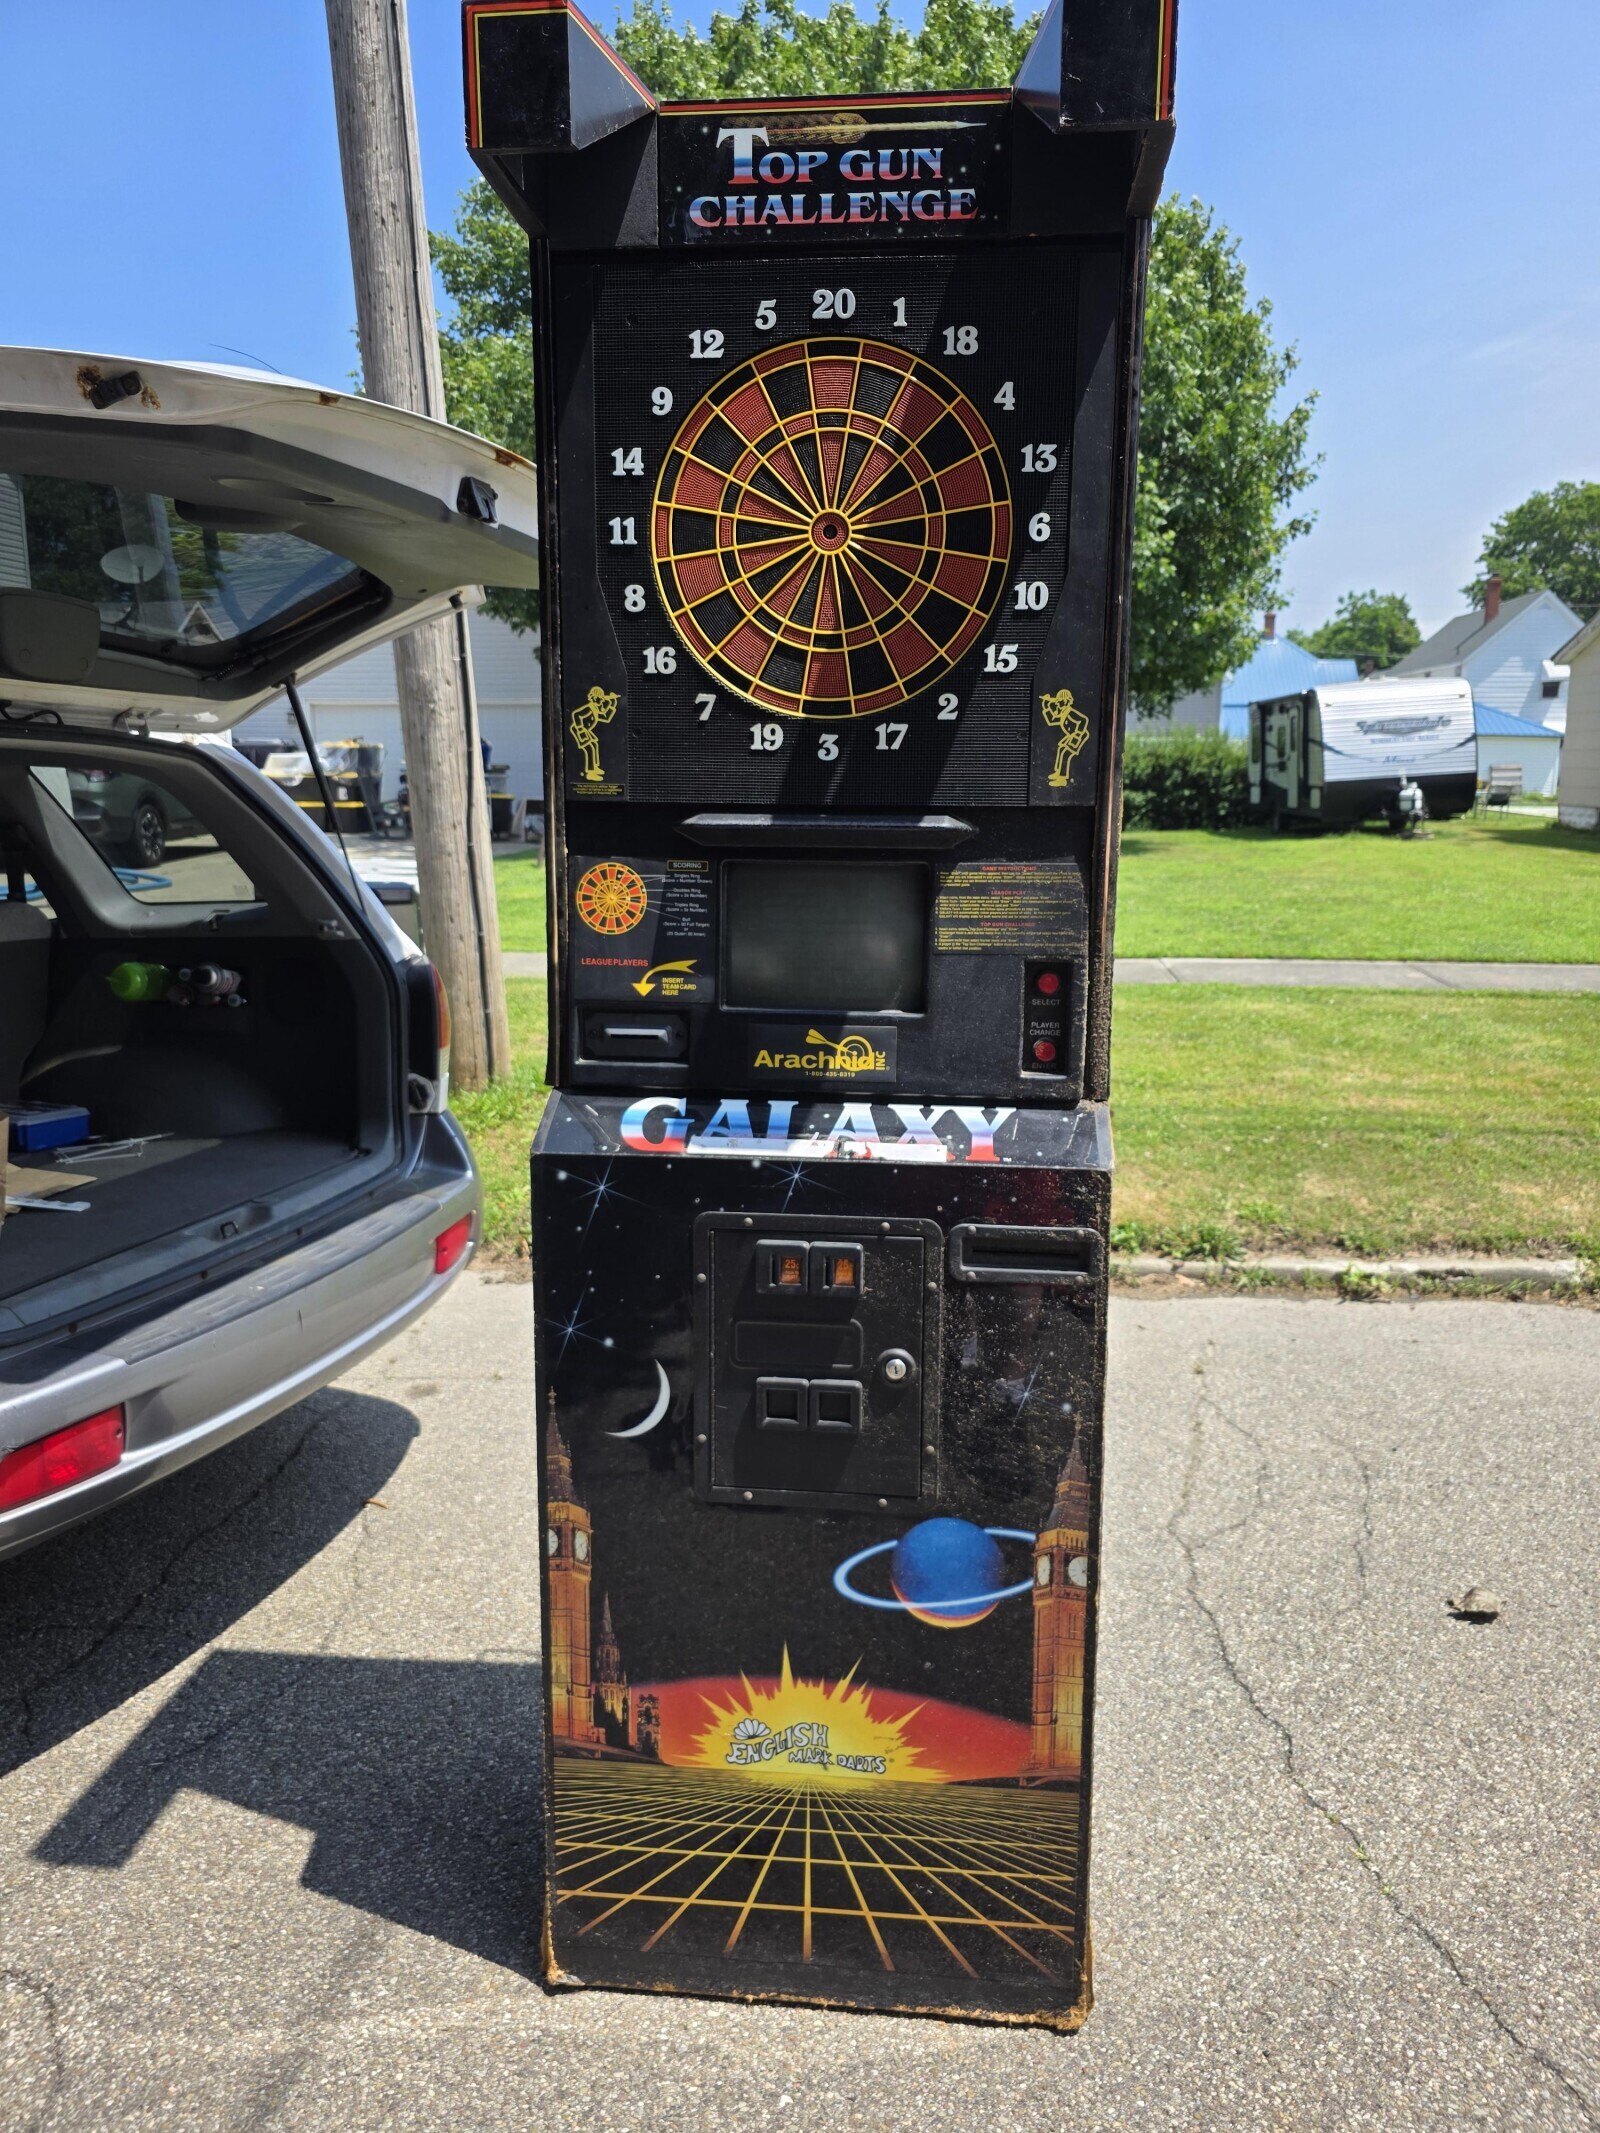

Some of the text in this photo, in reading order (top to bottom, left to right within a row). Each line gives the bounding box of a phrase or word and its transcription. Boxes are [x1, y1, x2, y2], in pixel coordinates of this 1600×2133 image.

[716, 127, 944, 185] TOP GUN
[689, 188, 979, 228] CHALLENGE
[754, 298, 777, 330] 5
[812, 288, 856, 319] 20
[892, 296, 908, 327] 1
[688, 329, 725, 359] 12
[942, 325, 979, 355] 18
[651, 386, 674, 416] 9
[993, 381, 1016, 411] 4
[610, 447, 645, 476] 14
[1020, 443, 1058, 473] 13
[608, 516, 638, 545] 11
[1028, 512, 1051, 542] 6
[624, 584, 646, 613] 8
[1013, 580, 1050, 611] 10
[642, 646, 677, 675] 16
[983, 643, 1019, 673] 15
[694, 692, 717, 721] 7
[937, 693, 959, 720] 2
[749, 722, 784, 751] 19
[817, 733, 839, 761] 3
[874, 722, 909, 750] 17
[581, 957, 649, 967] LEAGUE PLAYERS
[1031, 998, 1061, 1006] SELECT
[1030, 1021, 1060, 1029] PLAYER
[753, 1049, 875, 1070] Arachnid
[620, 1096, 1018, 1162] GALAXY
[725, 1722, 829, 1765] ENGLISH
[788, 1747, 887, 1774] MARK DARTS
